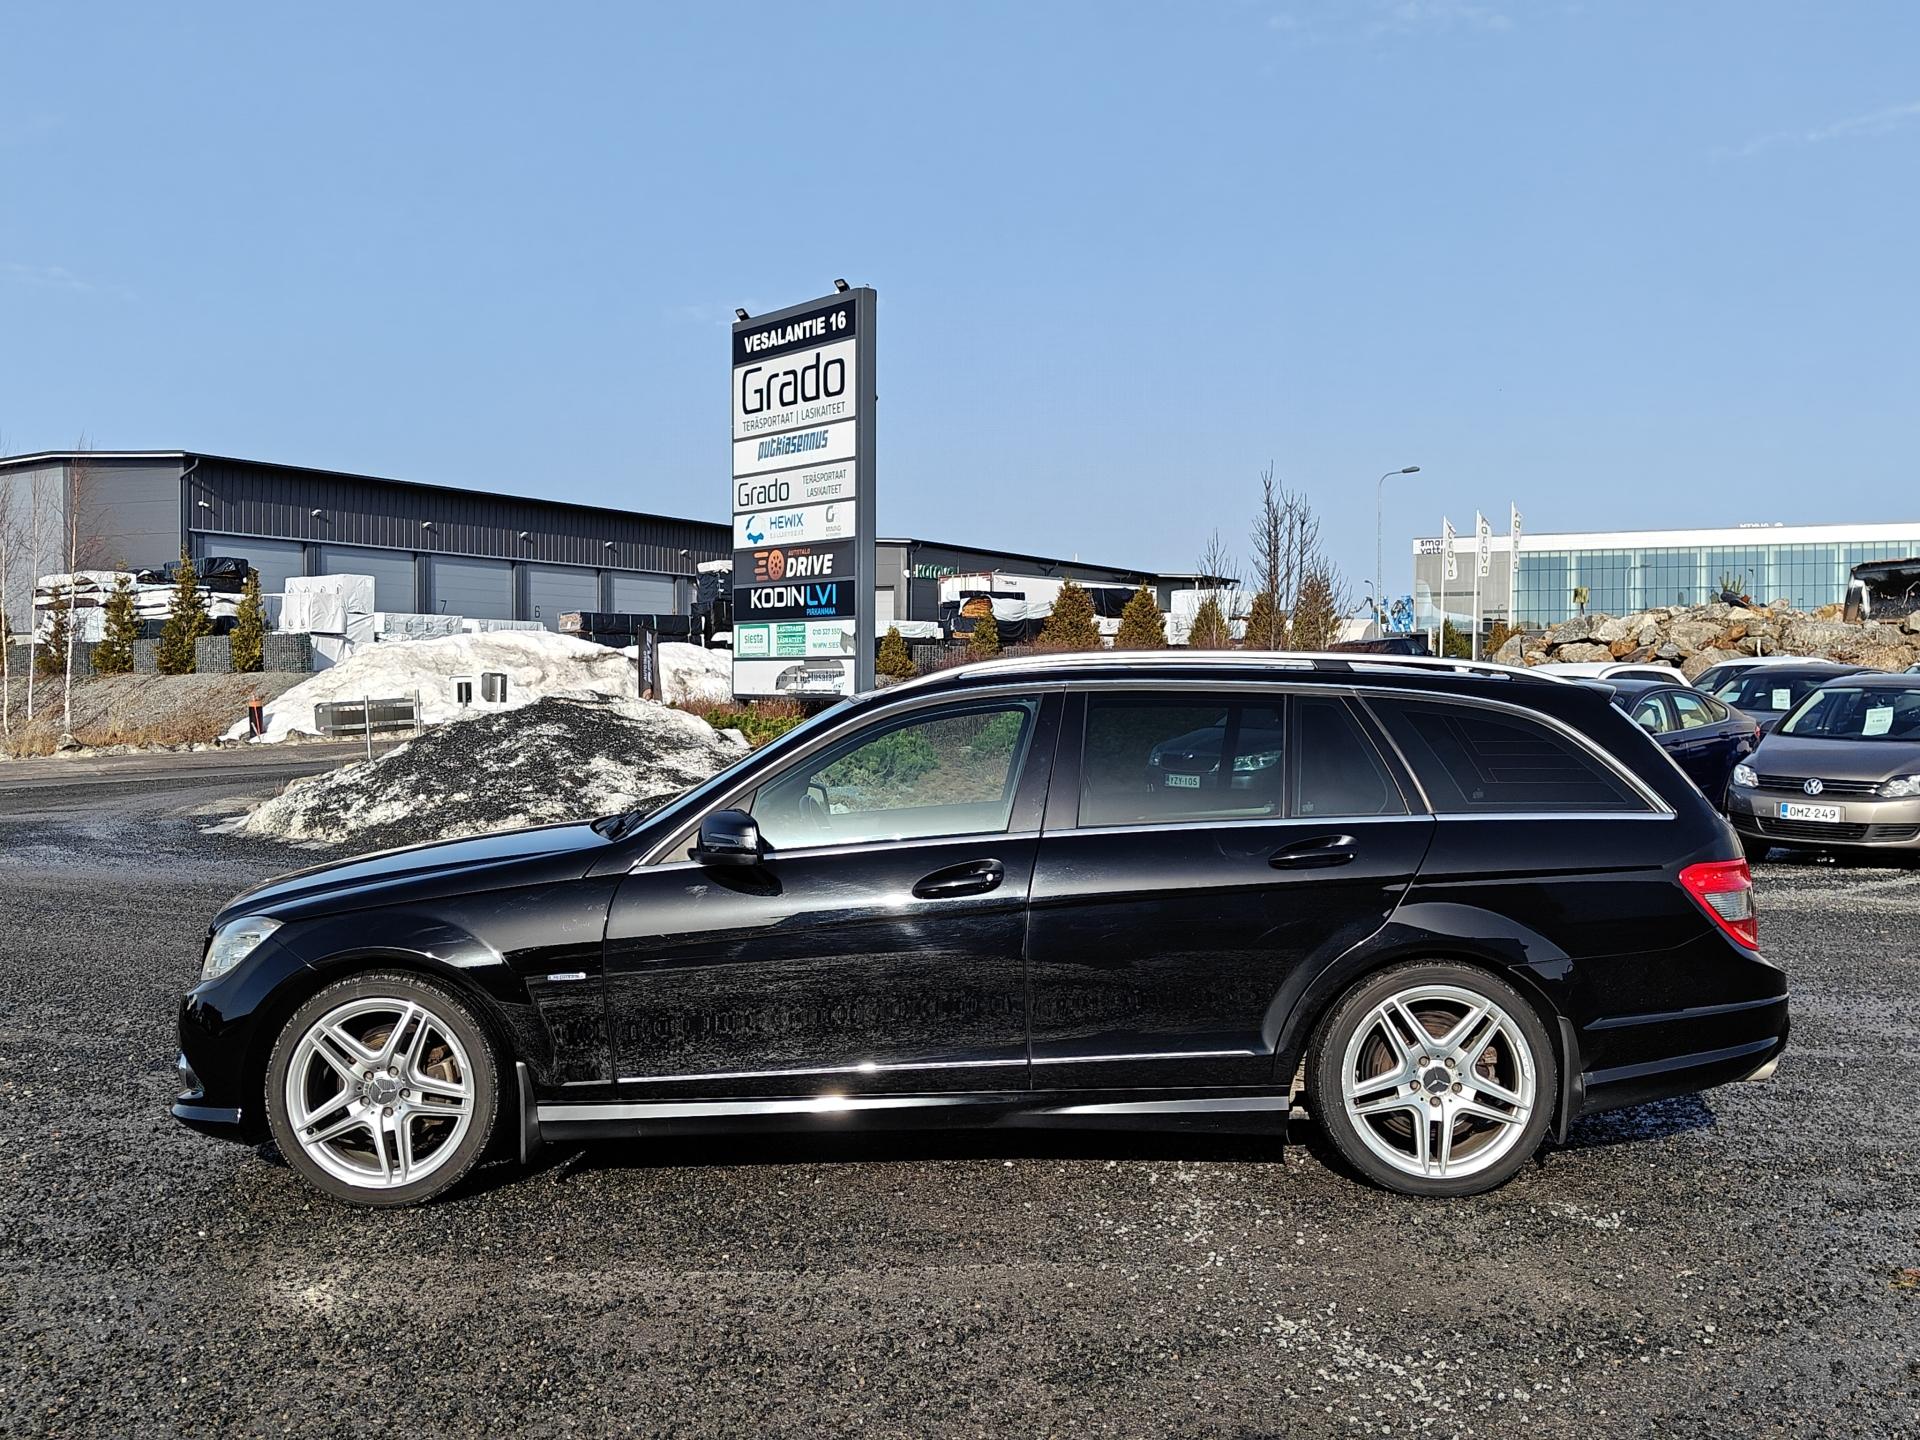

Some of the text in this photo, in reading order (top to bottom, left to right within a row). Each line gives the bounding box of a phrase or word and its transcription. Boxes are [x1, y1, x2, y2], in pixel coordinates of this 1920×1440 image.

[744, 310, 847, 353] VESALANTIE 16
[742, 352, 845, 415] Grado
[742, 401, 846, 433] TERÄSPORTAAT LASIKAITEET
[757, 429, 829, 462] putkiasennus
[802, 469, 847, 485] TERÄSPORTAAT
[738, 477, 790, 507] Grado
[806, 483, 842, 498] LASIKAITEET
[769, 512, 804, 531] HEWIX
[785, 553, 834, 578] DRIVE
[440, 599, 447, 614] 7
[534, 605, 541, 619] 6
[806, 607, 836, 616] PIRKANMAA
[744, 632, 764, 644] siesta
[1789, 806, 1836, 820] OMZ-249
